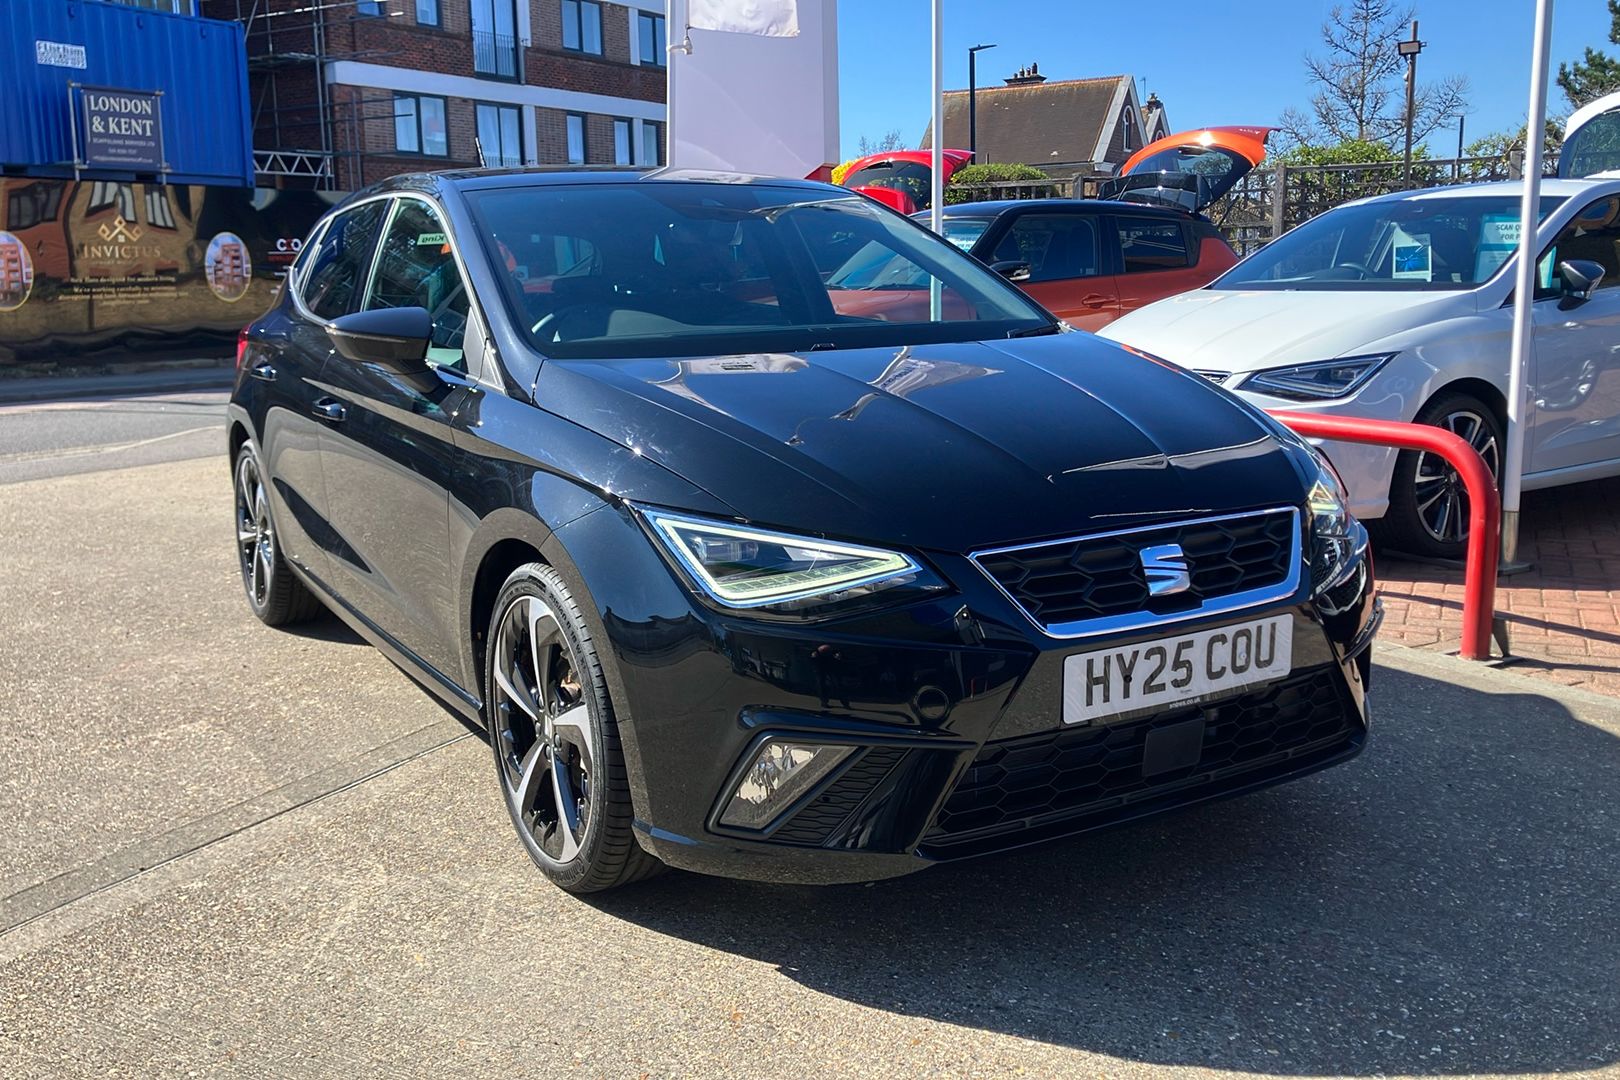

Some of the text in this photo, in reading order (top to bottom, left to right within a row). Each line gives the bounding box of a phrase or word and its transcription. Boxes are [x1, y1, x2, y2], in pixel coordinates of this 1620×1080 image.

[89, 95, 152, 115] LONDON
[92, 115, 153, 136] & KENT
[82, 243, 161, 258] INVICTUS
[1085, 622, 1277, 707] HY25 COU
